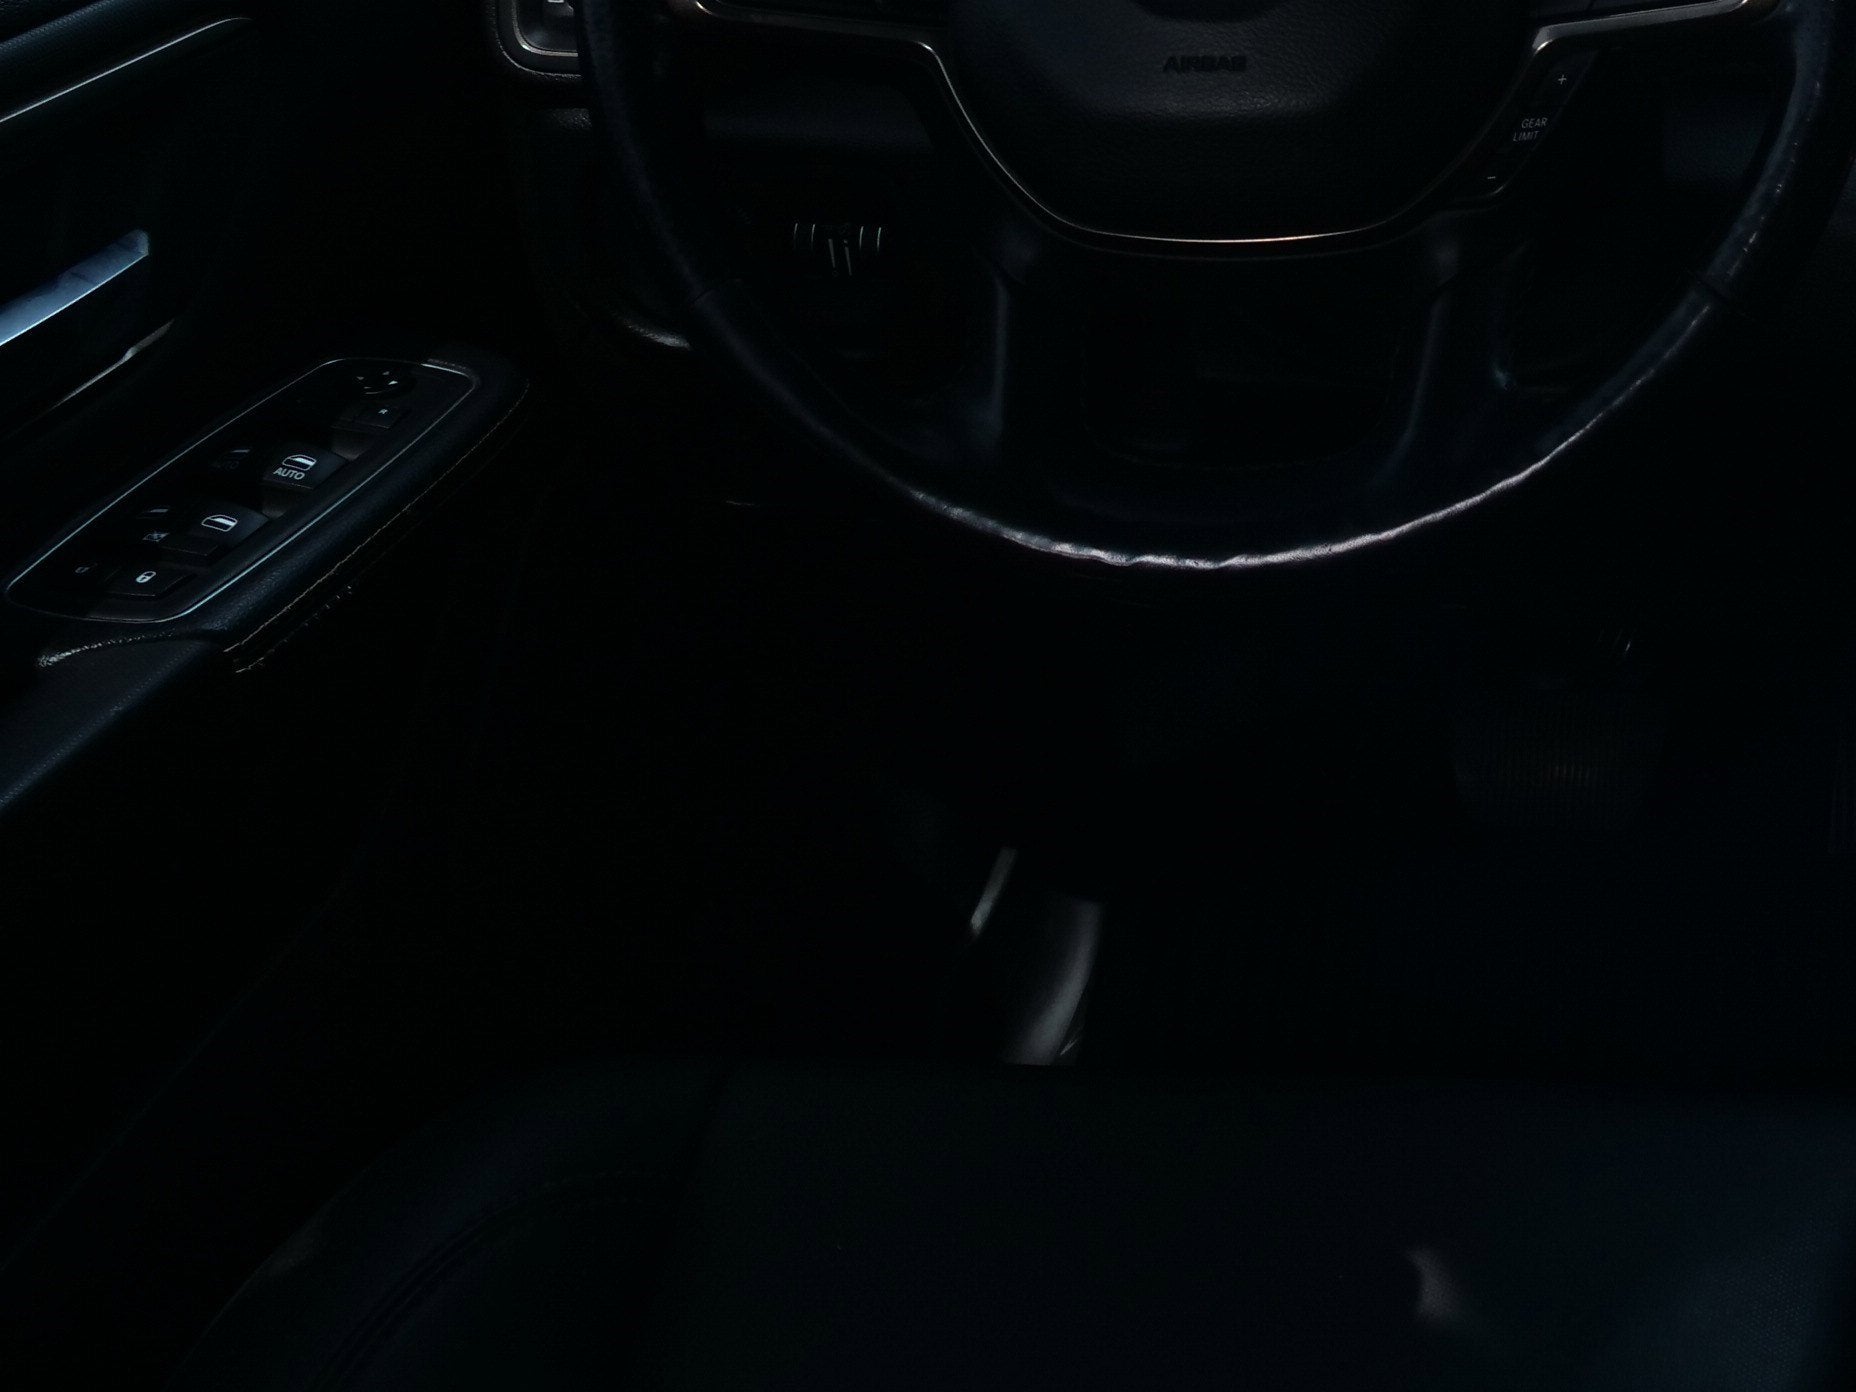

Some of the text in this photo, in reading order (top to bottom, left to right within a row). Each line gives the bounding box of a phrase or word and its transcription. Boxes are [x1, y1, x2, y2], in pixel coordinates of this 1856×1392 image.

[1520, 117, 1549, 129] GEAR
[1512, 130, 1540, 142] LIMIT
[273, 466, 305, 481] AUTO
